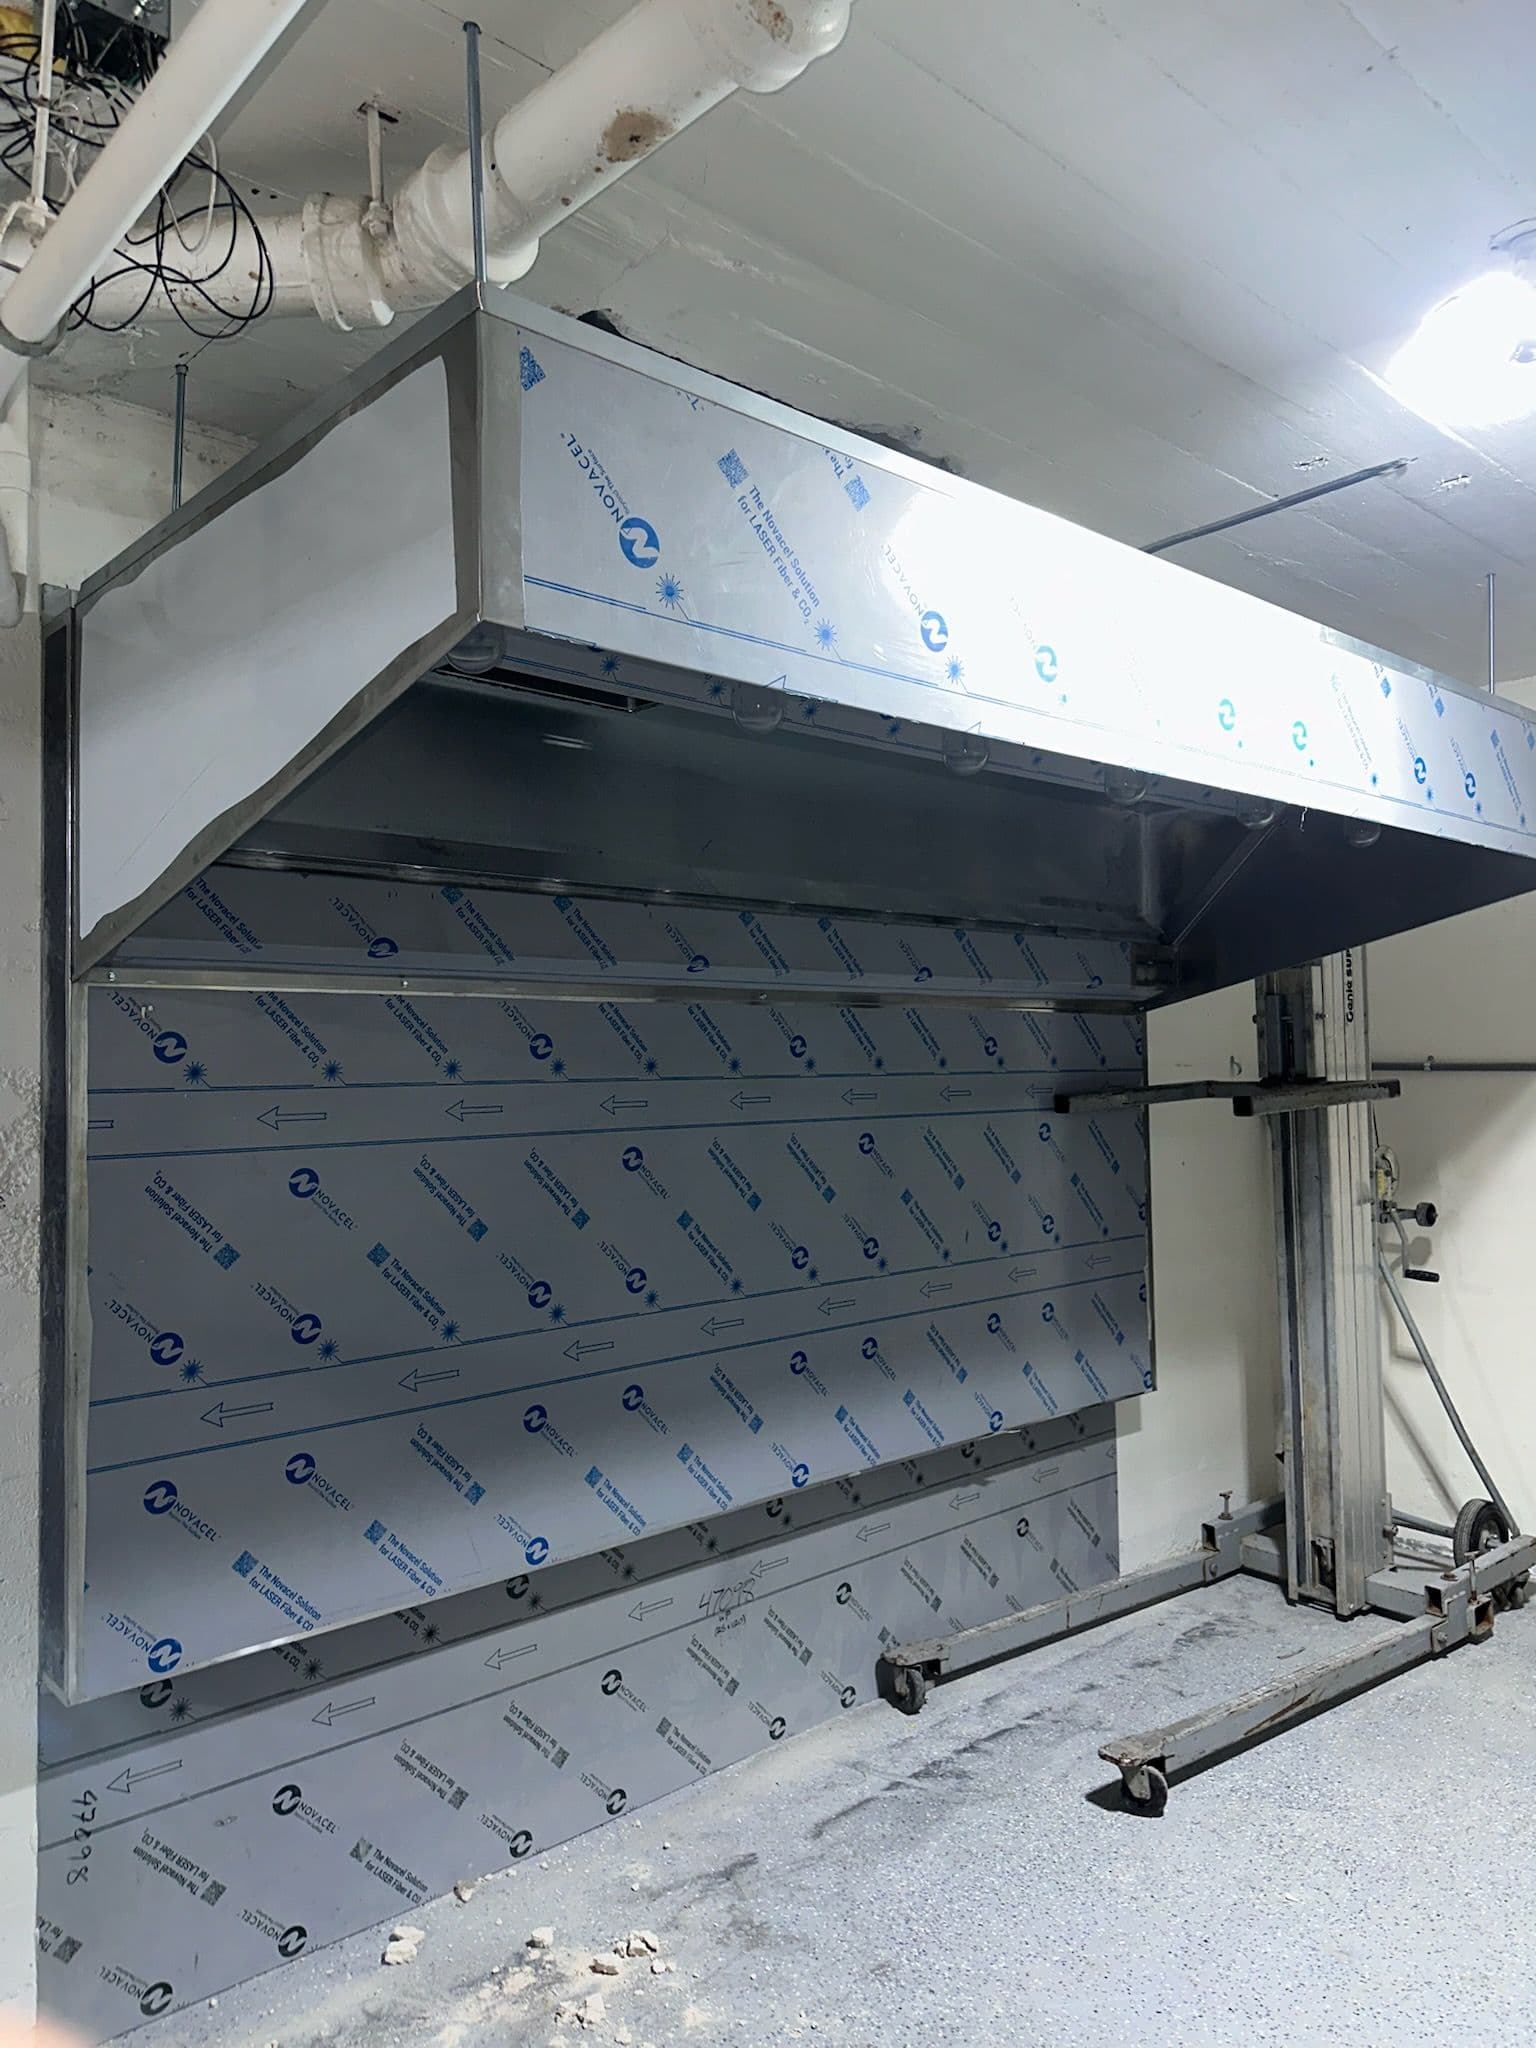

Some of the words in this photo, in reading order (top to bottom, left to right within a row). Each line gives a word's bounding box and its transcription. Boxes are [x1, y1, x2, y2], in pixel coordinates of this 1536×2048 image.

[565, 433, 623, 523] NOVACEL
[736, 495, 751, 516] for
[748, 514, 777, 558] LASER
[772, 555, 792, 588] Fiber
[748, 483, 764, 512] The
[761, 508, 794, 560] Novacel
[789, 555, 819, 608] Solution
[884, 544, 923, 616] NOVACEL
[332, 897, 372, 943] NOVACEL
[110, 991, 157, 1039] NOVACEL
[500, 1001, 532, 1039] NOVACEL
[144, 1184, 175, 1217] Solution
[171, 1191, 191, 1212] Fiber
[315, 1189, 354, 1230] NOVACEL
[169, 1210, 201, 1242] Novacel
[187, 1207, 213, 1233] LASER
[210, 1228, 224, 1242] for
[198, 1235, 213, 1253] The
[599, 1241, 628, 1275] NOVACEL
[389, 1257, 402, 1273] The
[399, 1267, 426, 1295] Novacel
[421, 1289, 445, 1317] Solution
[499, 1253, 530, 1289] NOVACEL
[254, 1282, 294, 1323] NOVACEL
[380, 1267, 392, 1280] for
[389, 1275, 412, 1299] LASER
[407, 1294, 424, 1312] Fiber
[108, 1299, 154, 1343] NOVACEL
[640, 1401, 668, 1434] NOVACEL
[544, 1423, 574, 1457] NOVACEL
[312, 1473, 351, 1510] NOVACEL
[173, 1501, 217, 1541] NOVACEL
[496, 1512, 528, 1547] NOVACEL
[377, 1543, 389, 1556] for
[386, 1551, 409, 1573] LASER
[405, 1567, 421, 1585] Fiber
[386, 1532, 399, 1548] The
[396, 1541, 423, 1568] Novacel
[418, 1560, 442, 1587] Solution
[247, 1576, 260, 1590] for
[257, 1584, 283, 1607] LASER
[279, 1601, 297, 1620] Fiber
[258, 1564, 272, 1581] The
[269, 1574, 299, 1601] Novacel
[293, 1594, 321, 1621] Solution
[105, 1612, 151, 1652] NOVACEL
[579, 1773, 608, 1800] NOVACEL
[298, 1802, 336, 1833] NOVACEL
[479, 1813, 510, 1841] NOVACEL
[132, 1844, 162, 1871] Solution
[159, 1843, 178, 1861] Fiber
[174, 1854, 200, 1876] LASER
[157, 1862, 188, 1887] Novacel
[185, 1879, 200, 1895] The
[197, 1869, 210, 1882] for
[240, 1908, 280, 1939] NOVACEL
[97, 1965, 142, 1997] NOVACEL
